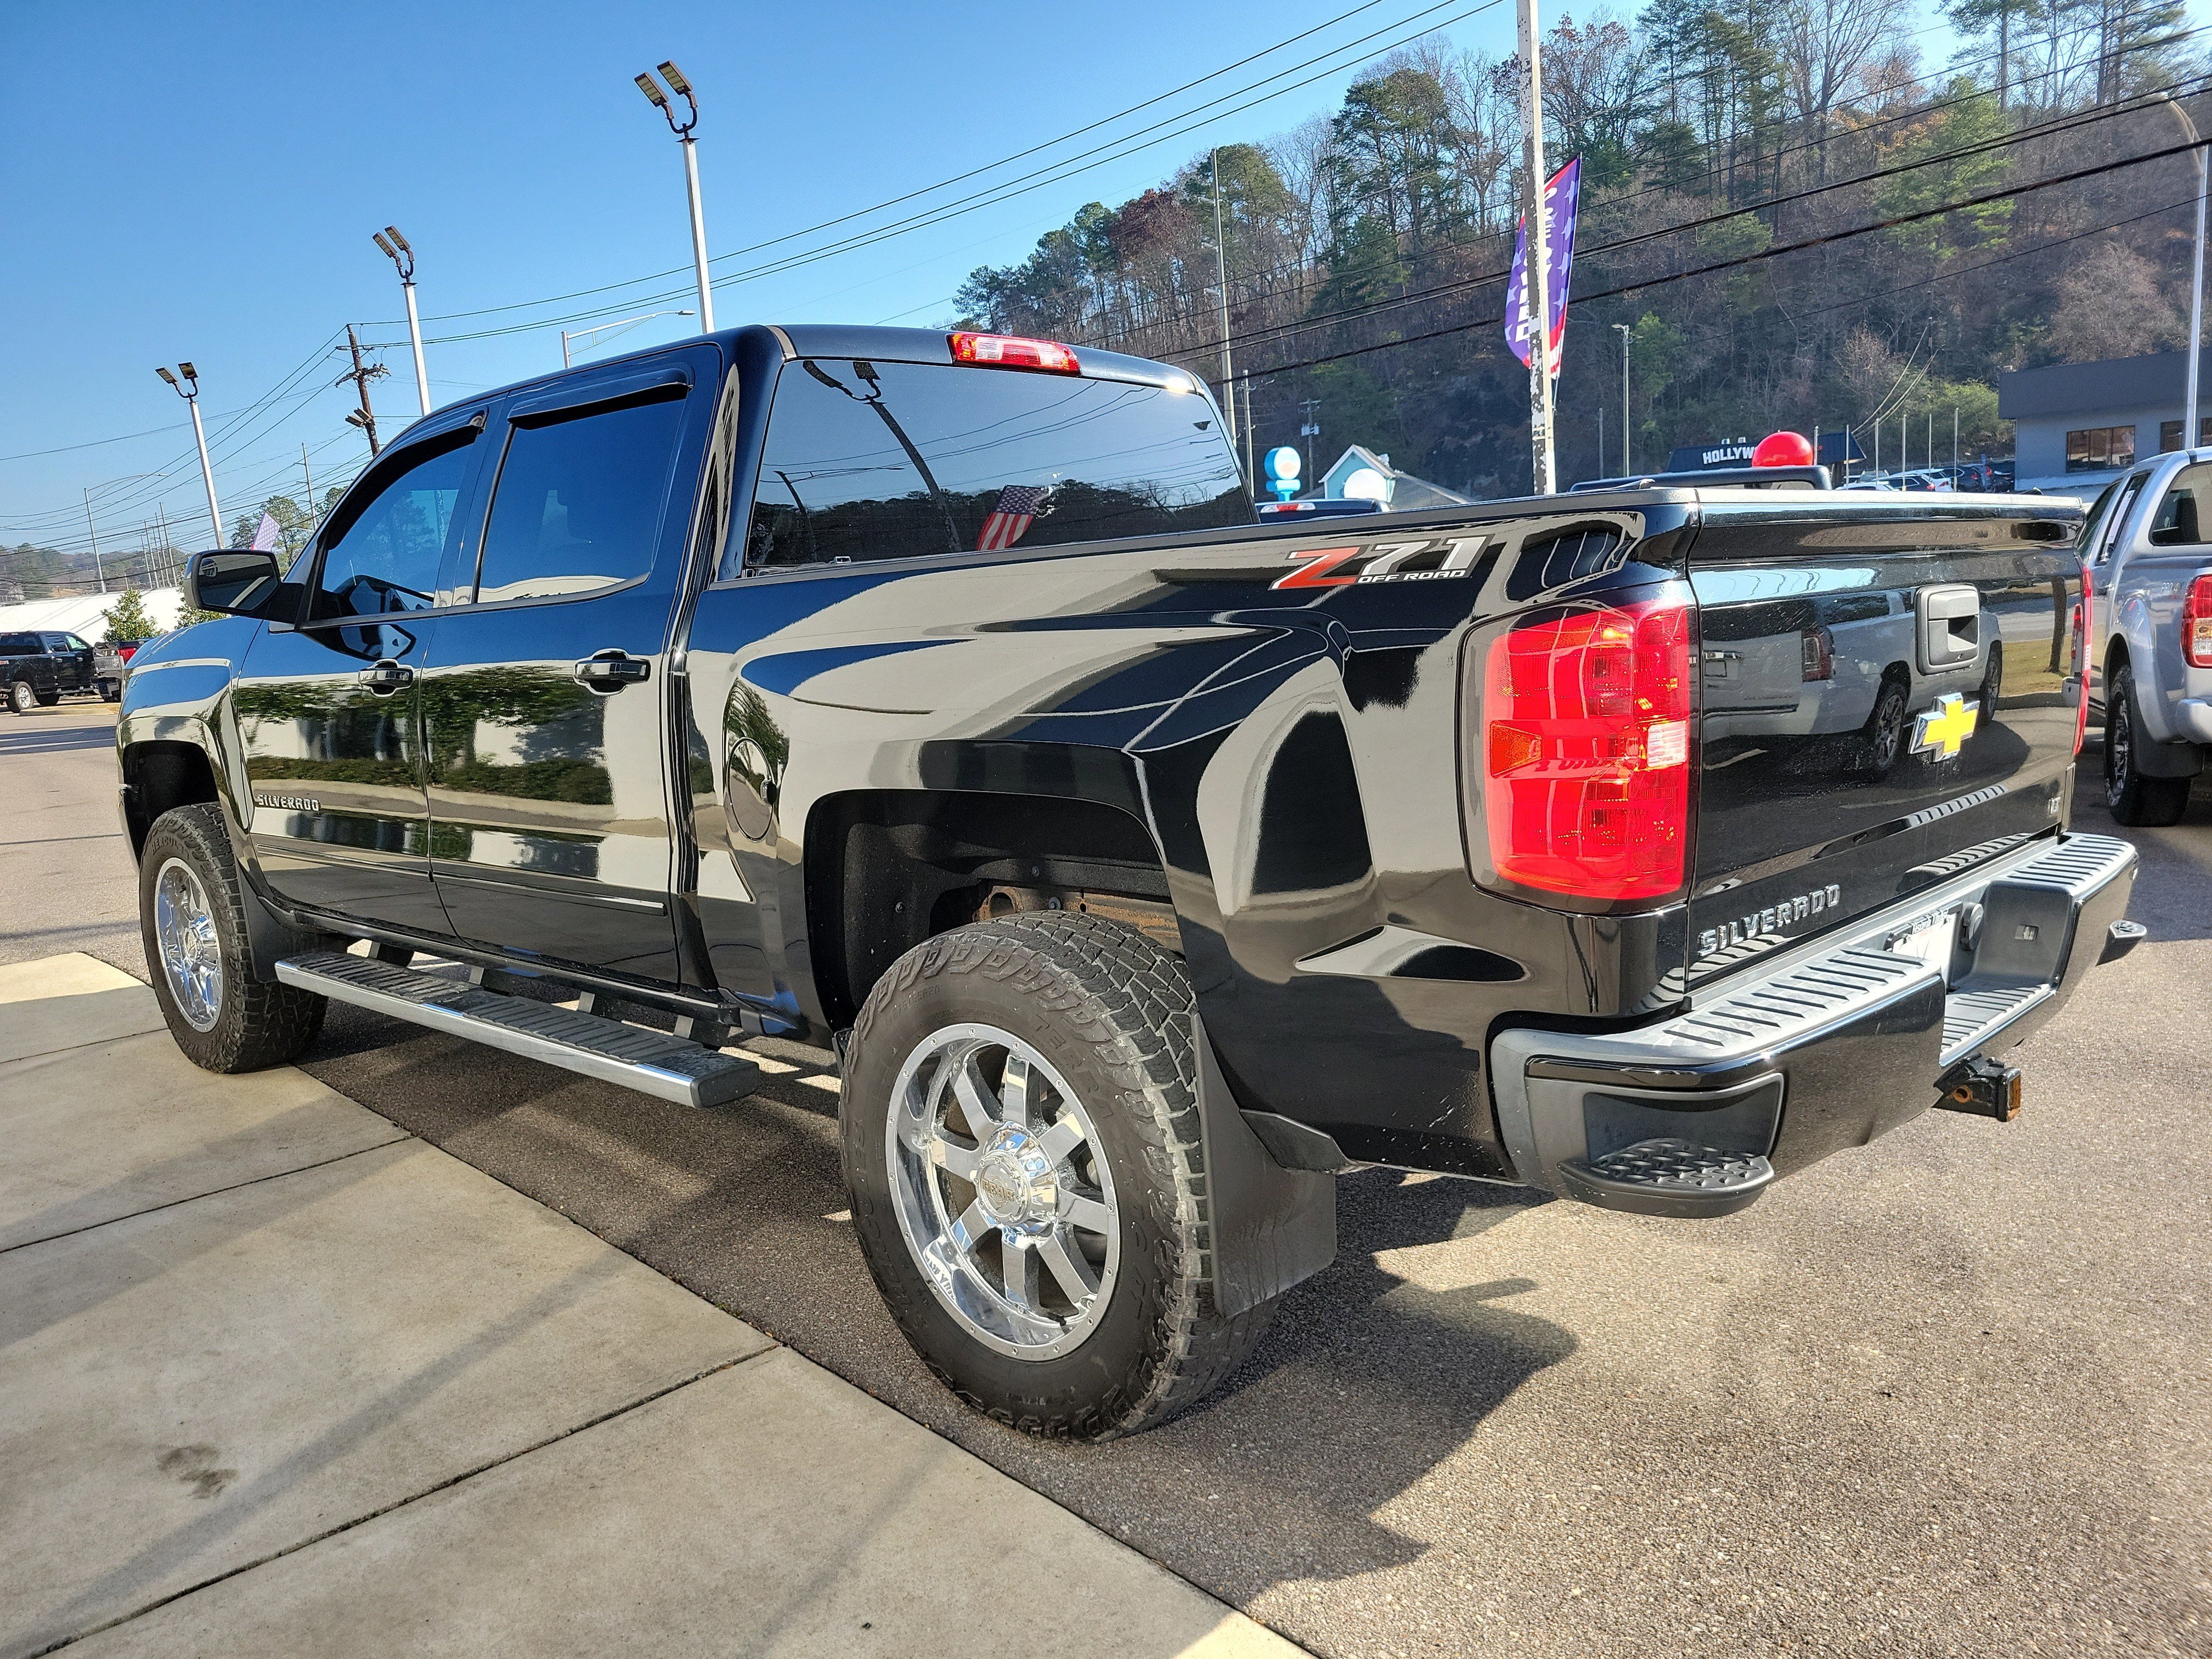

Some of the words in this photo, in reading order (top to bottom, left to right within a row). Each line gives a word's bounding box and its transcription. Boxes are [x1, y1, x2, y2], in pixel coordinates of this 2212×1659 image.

[1702, 447, 1755, 465] HOLLYW
[1268, 534, 1493, 590] Z71
[1357, 574, 1400, 584] OFF
[1403, 569, 1466, 581] ROAD
[257, 794, 320, 812] SILVERADO
[1697, 883, 1841, 957] SILVERADO
[981, 1178, 1015, 1203] GEAR
